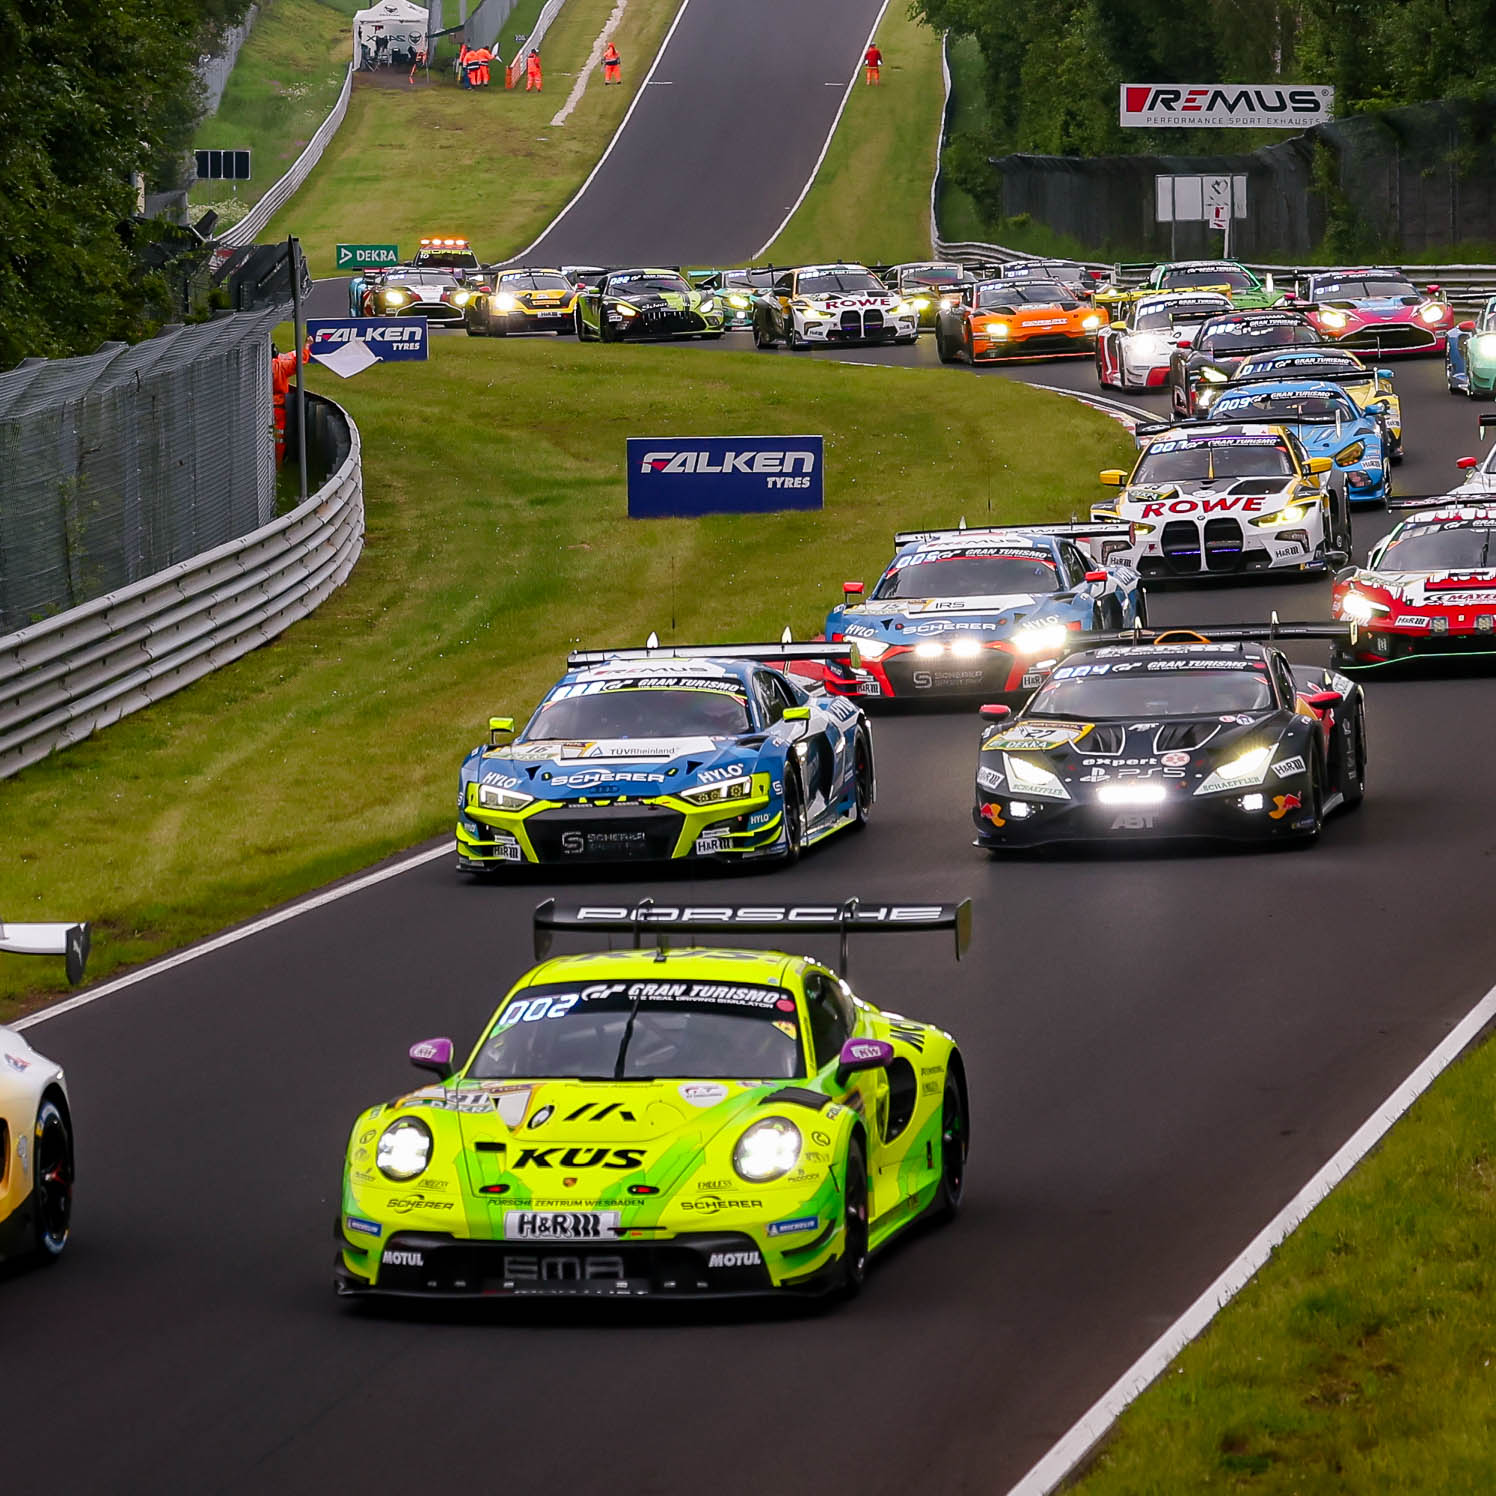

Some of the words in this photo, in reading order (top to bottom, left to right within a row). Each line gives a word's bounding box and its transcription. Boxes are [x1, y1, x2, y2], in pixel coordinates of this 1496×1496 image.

[1147, 89, 1321, 114] REMUS
[1147, 117, 1223, 125] PERFORMANCE
[1229, 117, 1262, 125] SPORT
[1267, 117, 1321, 125] EXHAUSTS
[356, 249, 397, 262] DEKRA
[826, 298, 891, 310] ROWE
[315, 327, 423, 343] FALKEN
[640, 451, 815, 473] FALKEN
[766, 477, 811, 488] TYRES
[1141, 497, 1266, 519] ROWE
[965, 548, 996, 557] GRAN
[998, 548, 1049, 559] TURISMO
[845, 623, 876, 637] HYLO
[903, 623, 996, 635] SCHERER
[1148, 661, 1185, 669] GRAN
[1188, 661, 1246, 669] TURISMO
[638, 677, 676, 686] GRAN
[680, 678, 741, 692] TURISMO
[1083, 758, 1158, 766] expert
[551, 772, 665, 785] SCHERER
[698, 765, 742, 784] HYLO
[1118, 767, 1186, 779] PS5
[483, 772, 516, 789] HYLO
[1203, 776, 1260, 792] SCHAEFFLER
[1012, 784, 1063, 796] SCHAEFFLER
[750, 815, 770, 825] HYLO
[577, 906, 942, 921] PORSCHE
[628, 983, 689, 997] GRAN
[691, 985, 780, 1003] TURISMO
[498, 993, 579, 1025] 002
[512, 1147, 648, 1170] KÜS
[387, 1197, 454, 1211] SCHERER
[487, 1199, 532, 1207] PORSCHE
[534, 1199, 580, 1207] ZENTRUM
[582, 1199, 645, 1208] WIESBADEN
[681, 1199, 763, 1211] SCHERER
[518, 1213, 571, 1239] H&R
[383, 1251, 424, 1266] MOTUL
[708, 1252, 761, 1268] MOTUL
